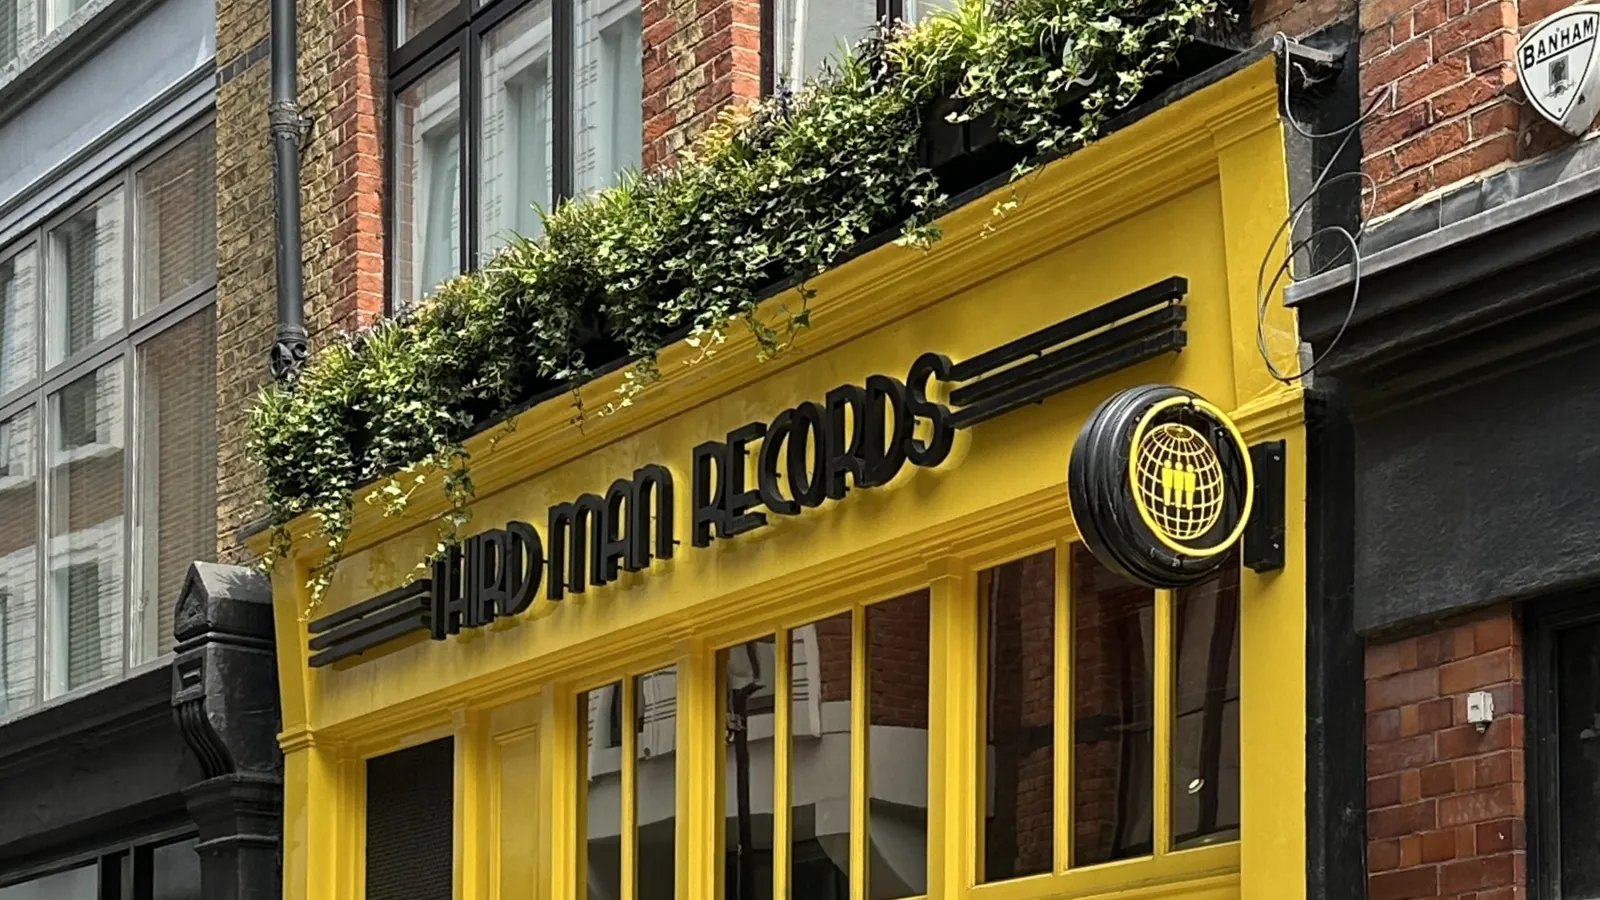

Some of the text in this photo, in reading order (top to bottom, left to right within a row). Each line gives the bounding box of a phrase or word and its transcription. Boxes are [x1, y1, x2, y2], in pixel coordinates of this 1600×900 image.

[1523, 16, 1594, 70] BANHAM
[547, 464, 674, 601] MAN
[691, 352, 956, 549] RECORDS
